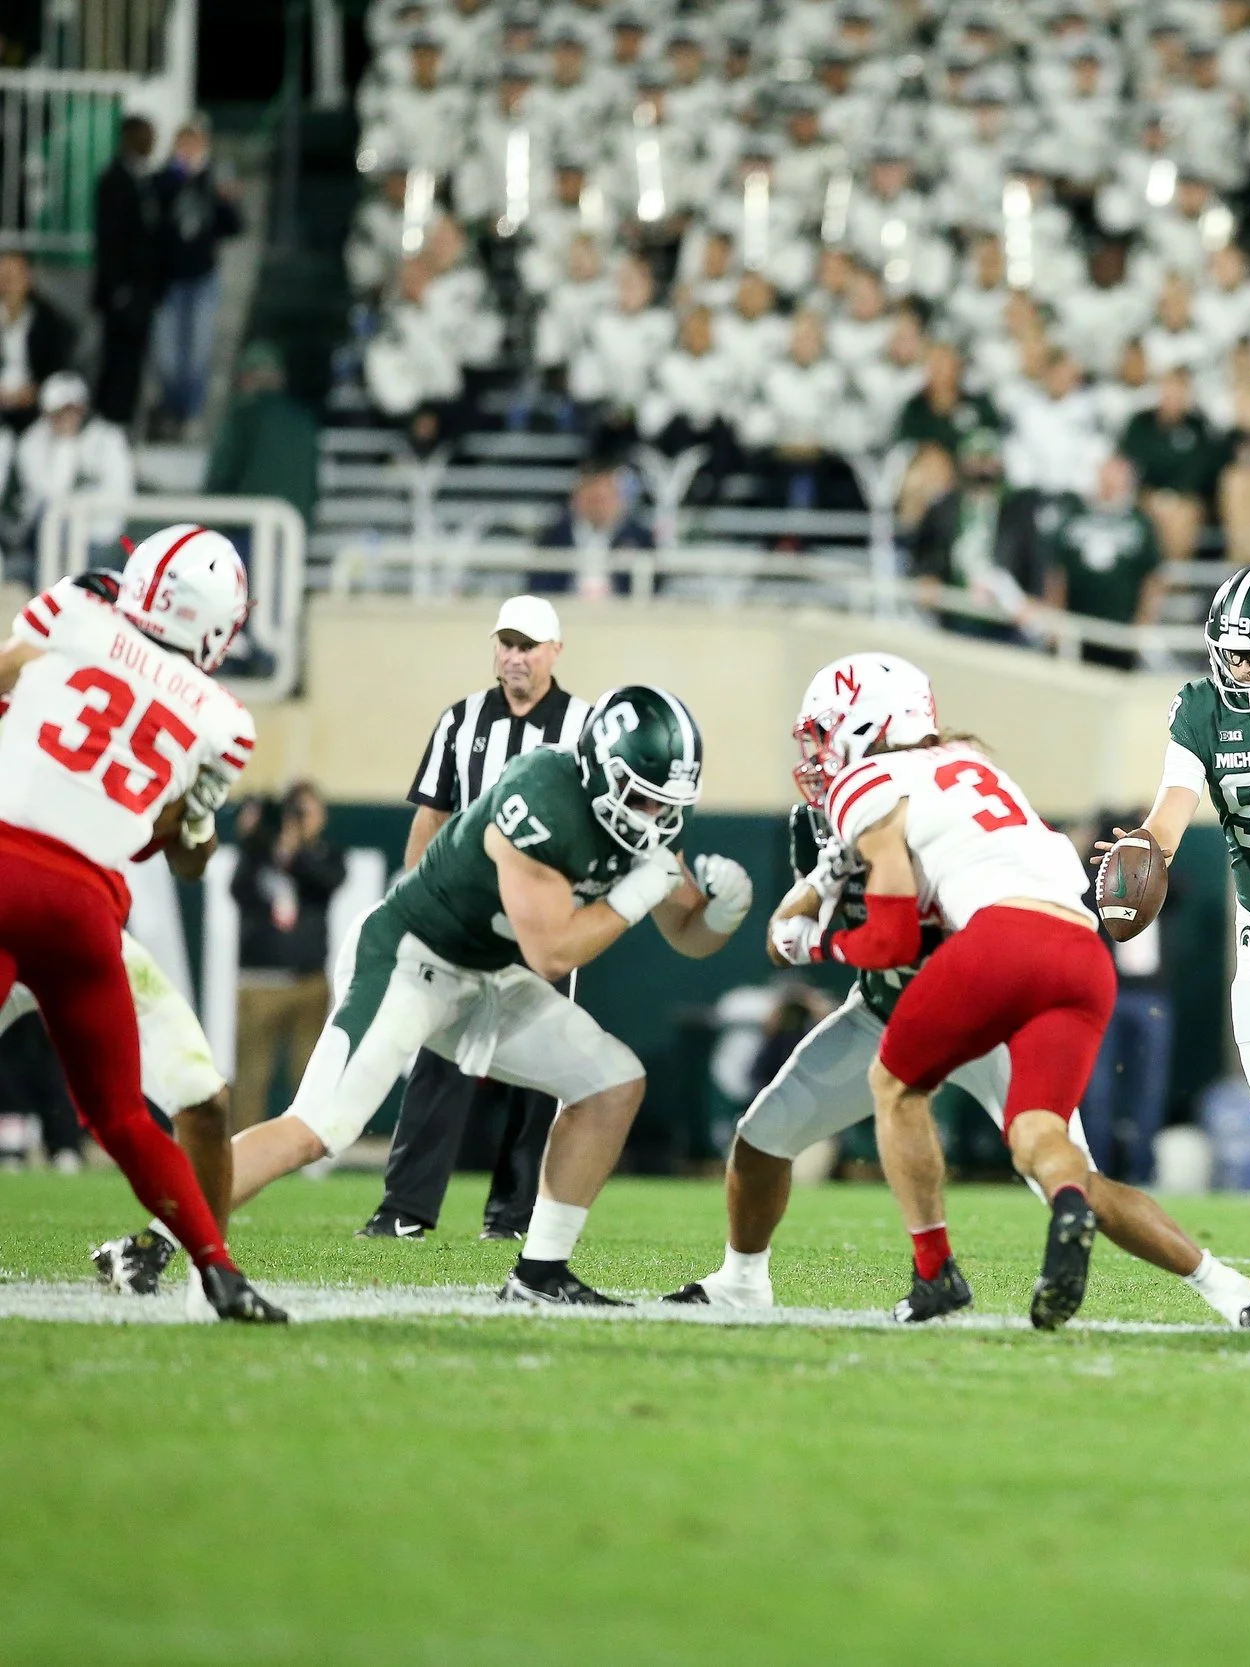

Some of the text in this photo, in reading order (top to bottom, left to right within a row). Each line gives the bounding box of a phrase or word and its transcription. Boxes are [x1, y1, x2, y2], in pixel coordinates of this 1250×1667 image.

[109, 631, 208, 717] BULLOCK
[38, 667, 197, 815] 35
[472, 736, 487, 753] S
[592, 701, 640, 752] S
[496, 793, 552, 850] 97
[934, 760, 1027, 832] 3
